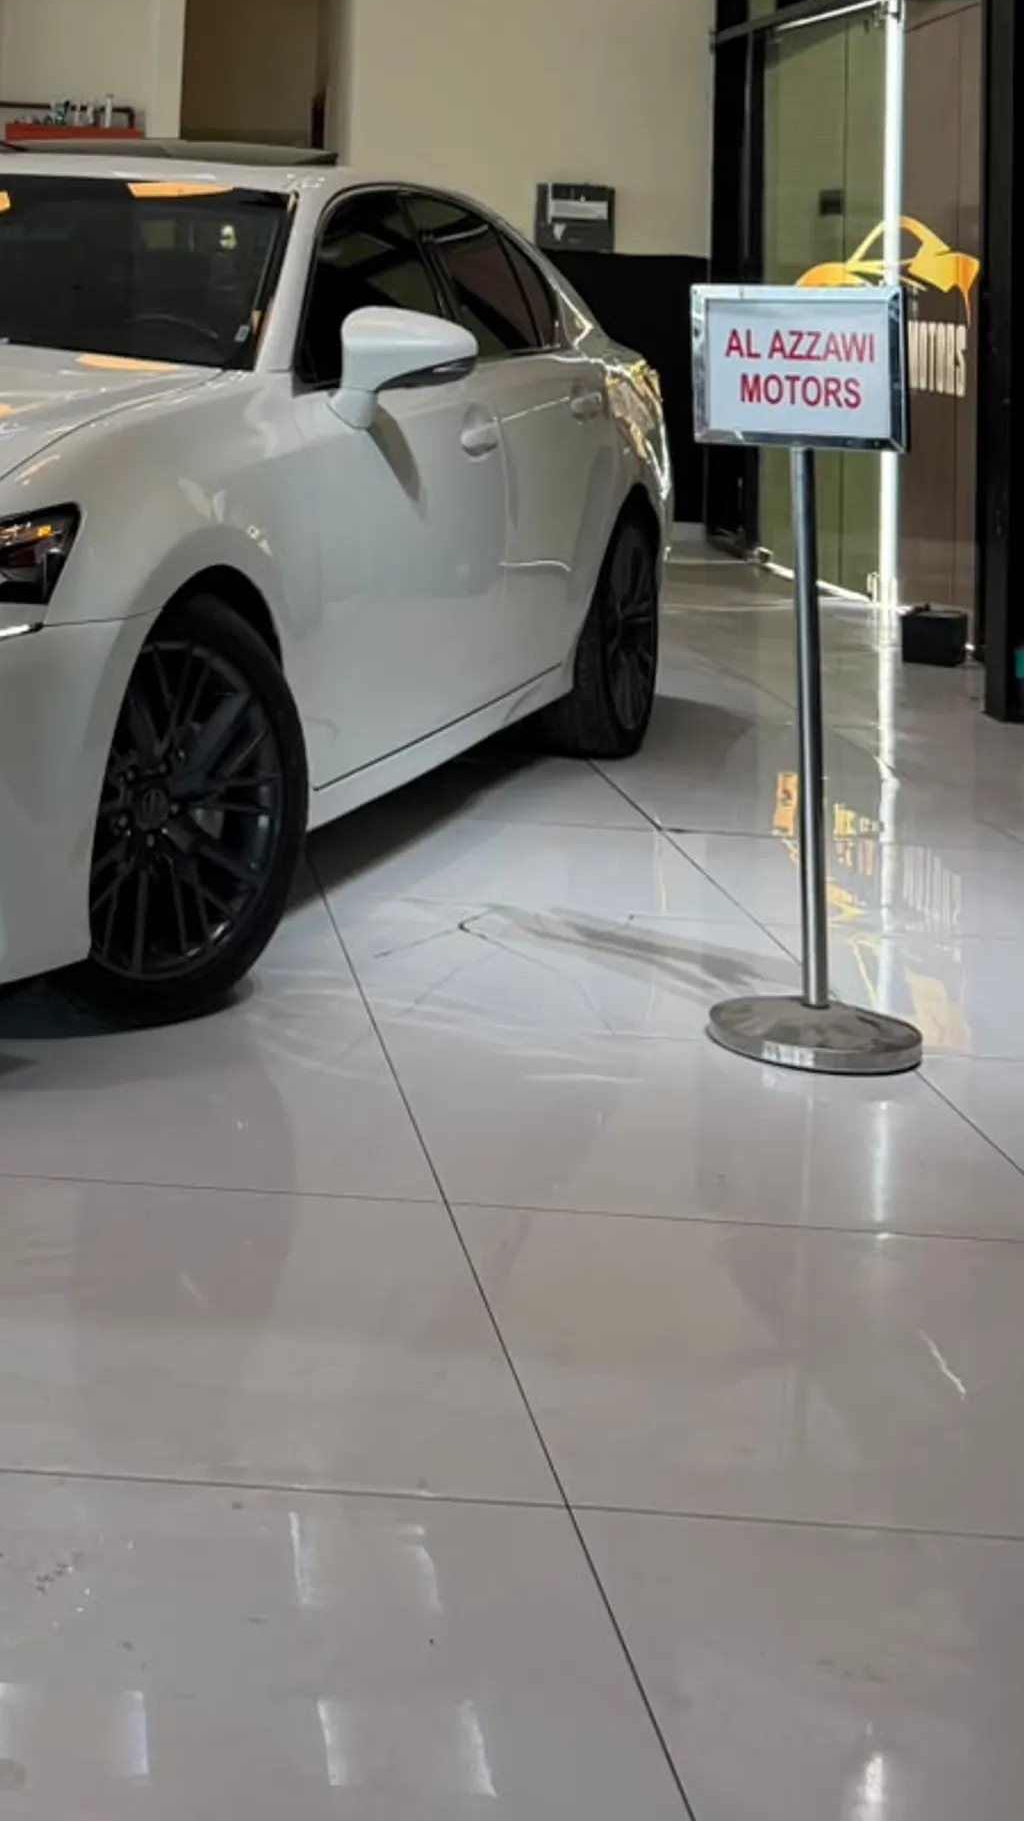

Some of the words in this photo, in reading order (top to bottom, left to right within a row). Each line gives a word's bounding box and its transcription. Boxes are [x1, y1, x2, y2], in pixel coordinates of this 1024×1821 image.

[725, 329, 761, 359] AL
[768, 329, 875, 363] AZZAWI
[740, 374, 862, 409] MOTORS
